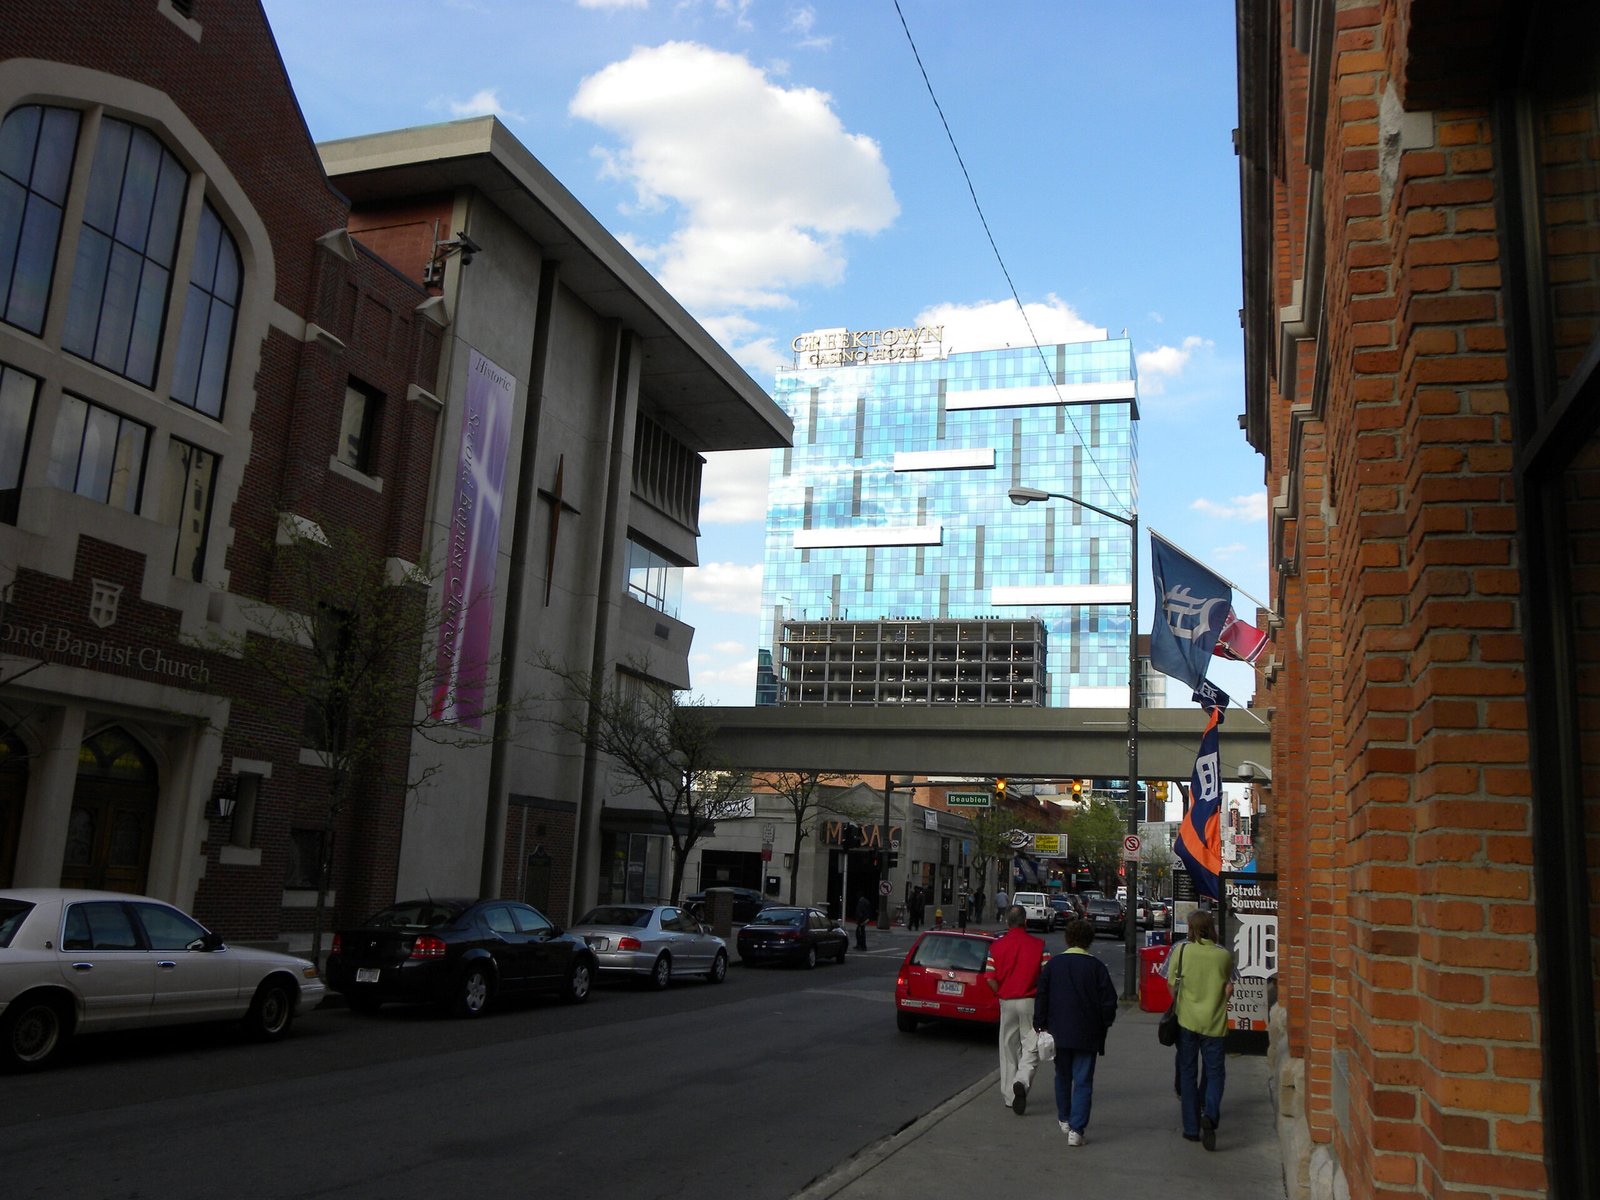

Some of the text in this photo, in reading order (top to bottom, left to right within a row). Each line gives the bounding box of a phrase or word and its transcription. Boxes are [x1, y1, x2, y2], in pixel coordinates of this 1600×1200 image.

[791, 325, 944, 352] GREEKTOWN
[474, 357, 511, 392] Historic
[453, 490, 473, 572] Baptist
[55, 628, 134, 667] Baptist
[138, 648, 210, 683] Church
[825, 820, 902, 848] MSAC
[1225, 884, 1262, 897] Detroit
[1226, 1001, 1259, 1013] Store
